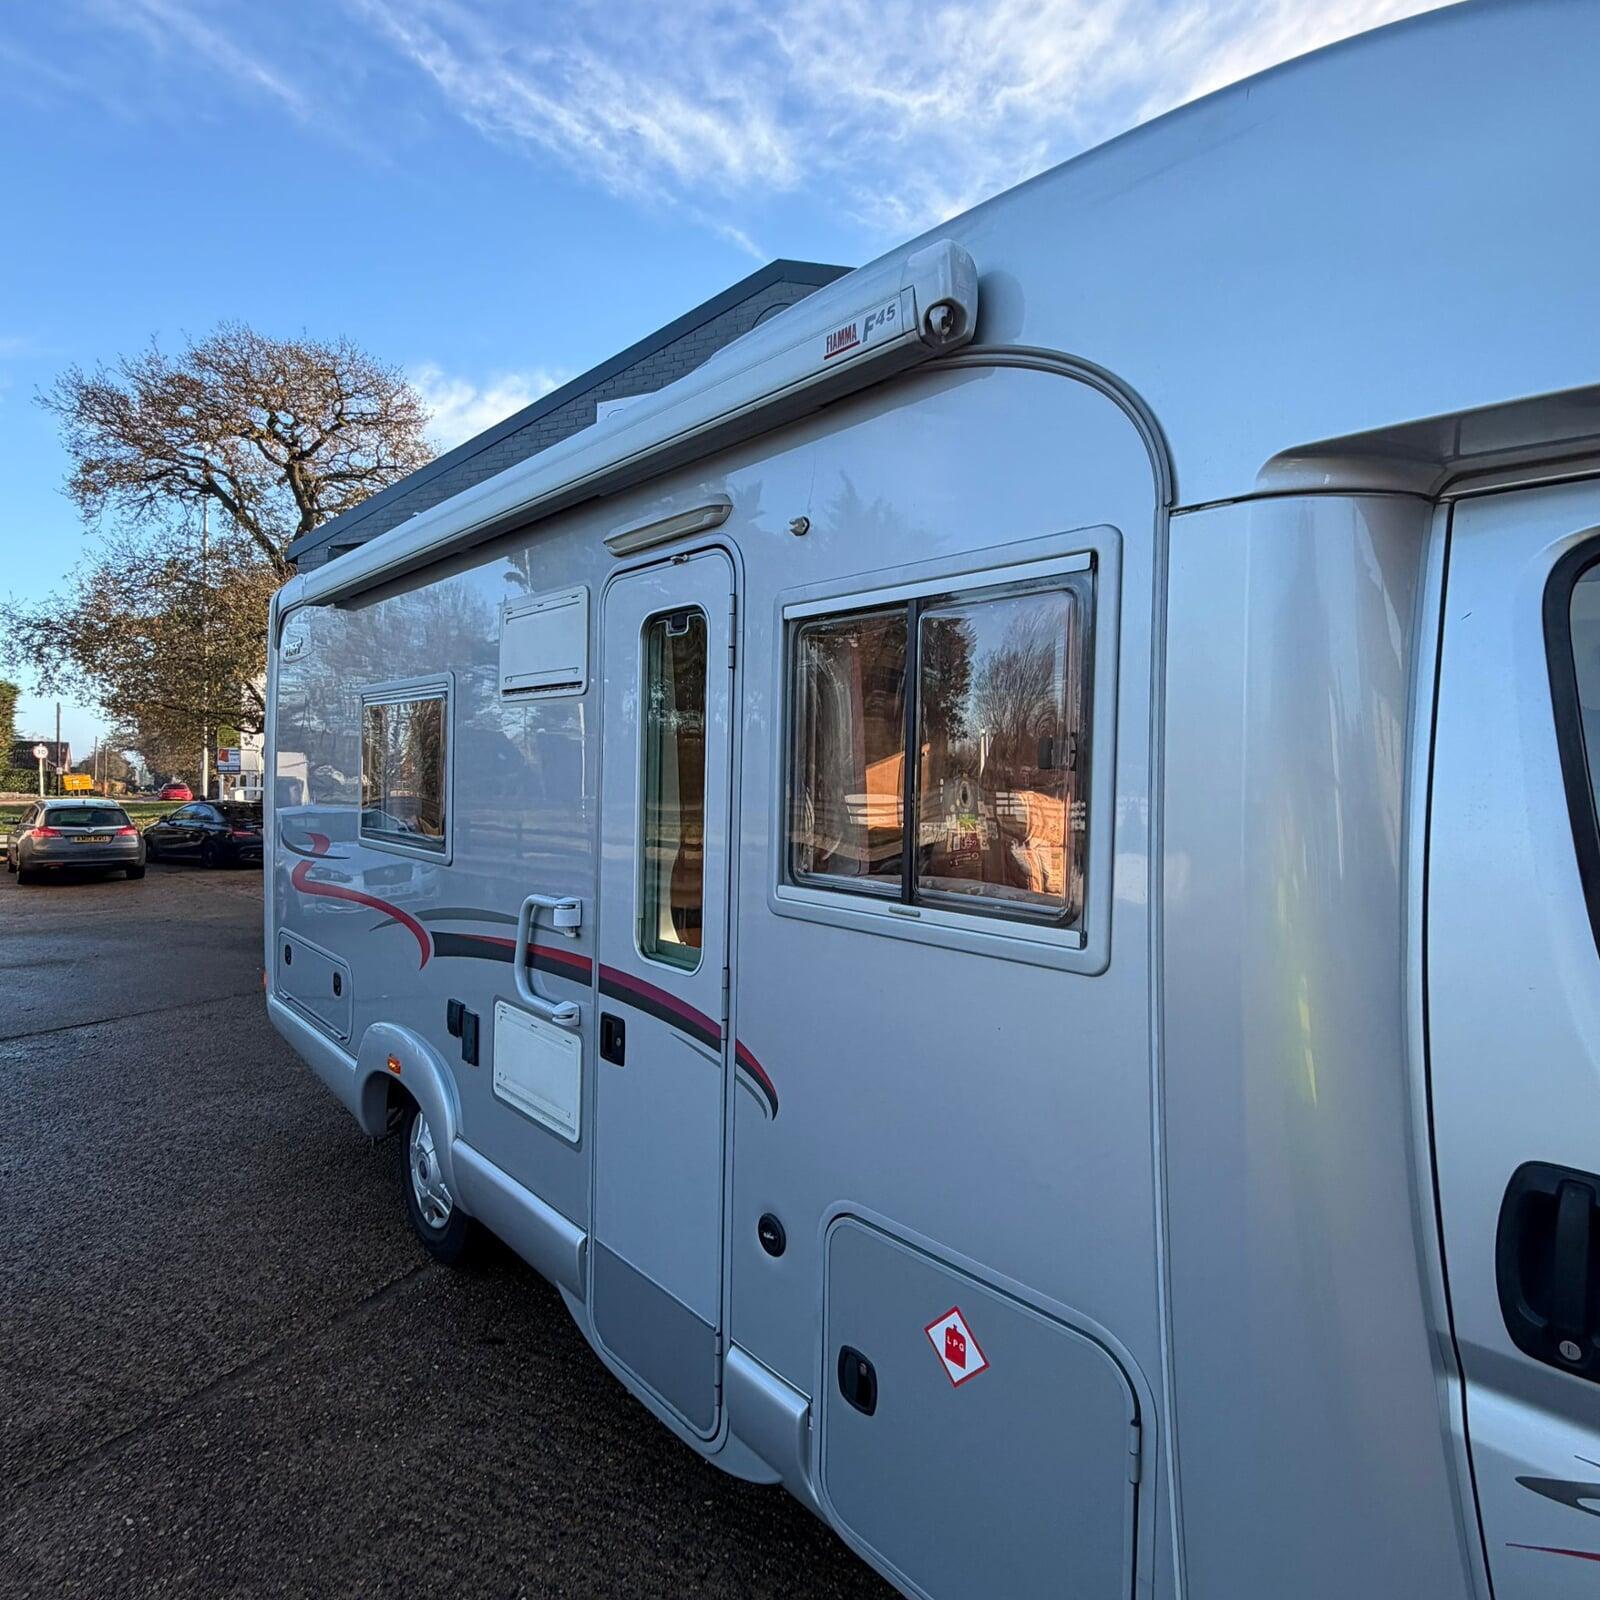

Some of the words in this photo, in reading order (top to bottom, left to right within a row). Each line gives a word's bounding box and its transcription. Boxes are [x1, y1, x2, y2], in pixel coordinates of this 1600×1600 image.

[826, 323, 857, 354] FIAMMA
[862, 303, 896, 343] F45
[946, 1336, 965, 1352] LPG
